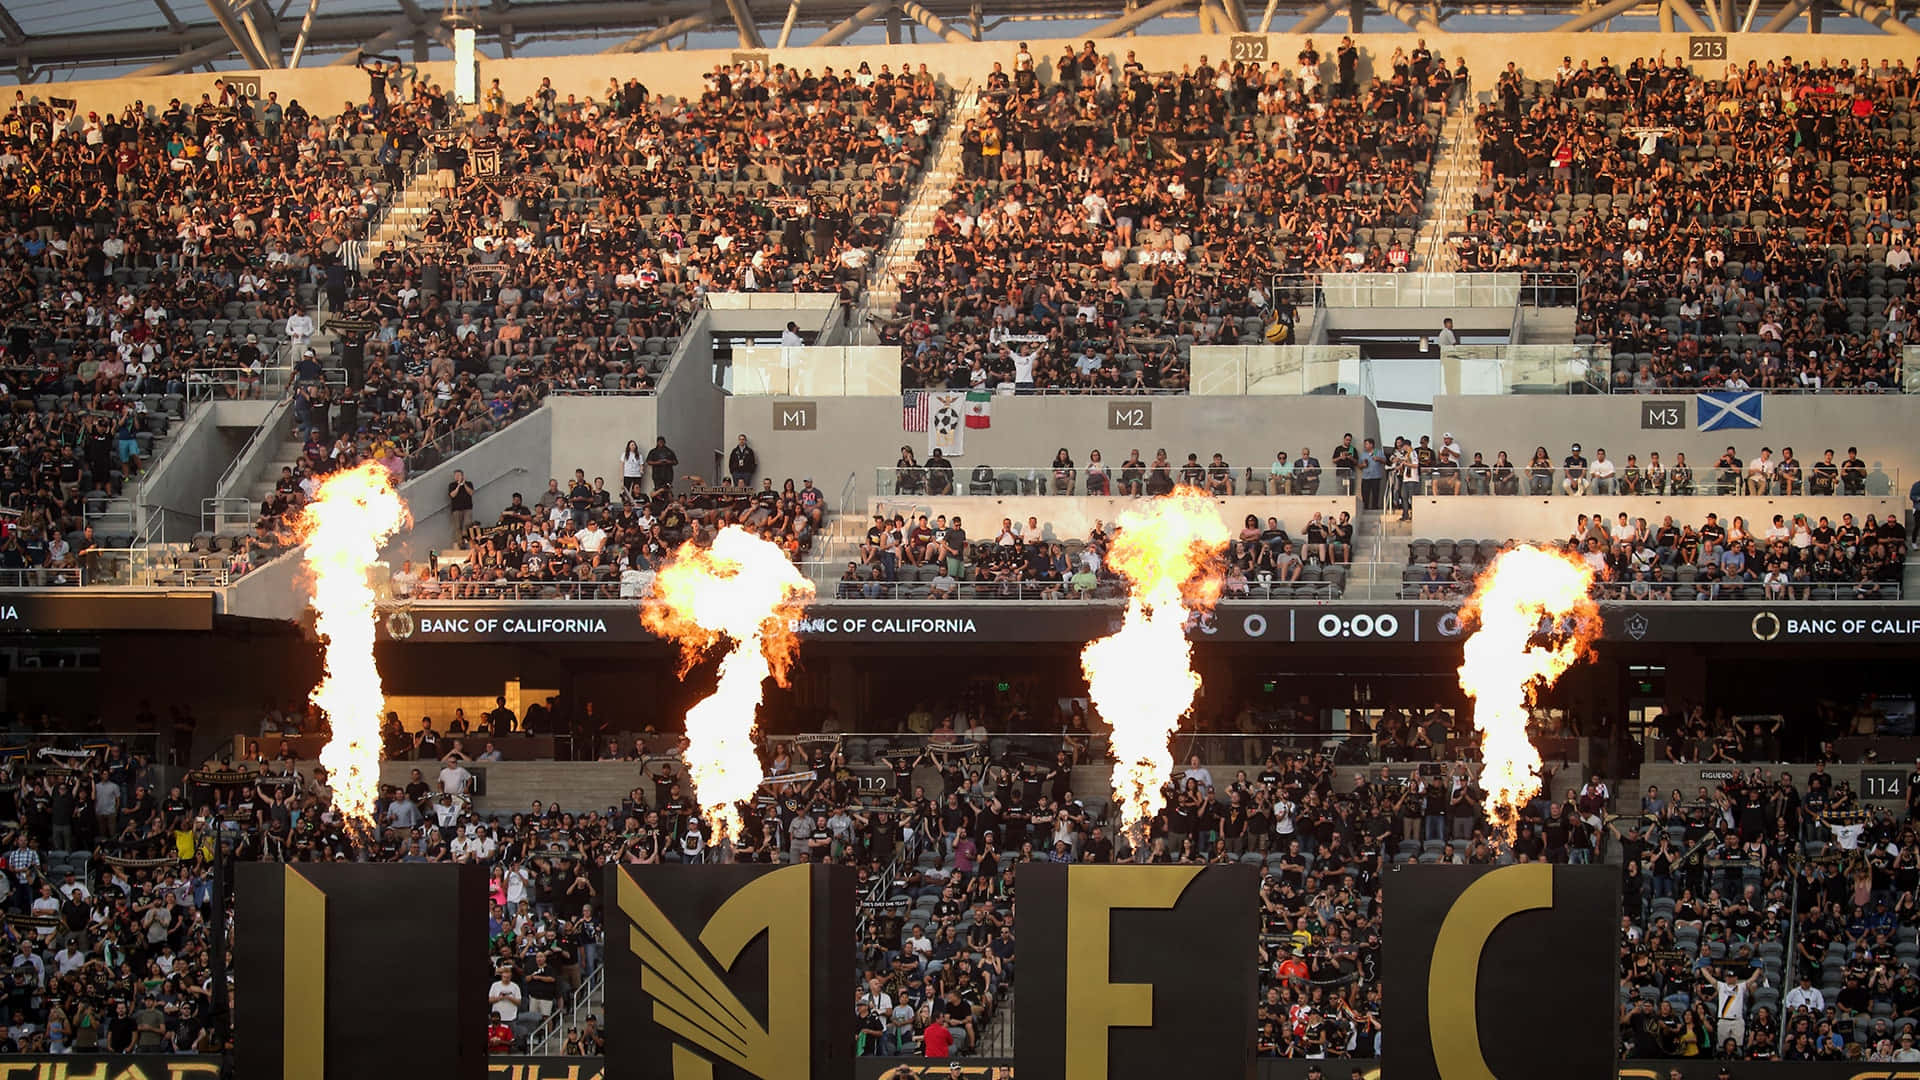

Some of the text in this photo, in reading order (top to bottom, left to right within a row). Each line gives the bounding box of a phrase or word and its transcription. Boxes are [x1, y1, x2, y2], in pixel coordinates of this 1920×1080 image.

[1234, 41, 1265, 59] 212
[1693, 42, 1723, 57] 213
[783, 410, 806, 426] M1
[1116, 409, 1144, 426] M2
[1649, 409, 1679, 426] M3
[421, 619, 607, 633] BANC OF CALIFORNIA
[843, 619, 868, 633] OF
[871, 619, 977, 633] CALIFORNIA
[1318, 614, 1398, 637] 0:00
[1787, 620, 1920, 633] BANC OF CALIF
[1867, 778, 1899, 795] 114
